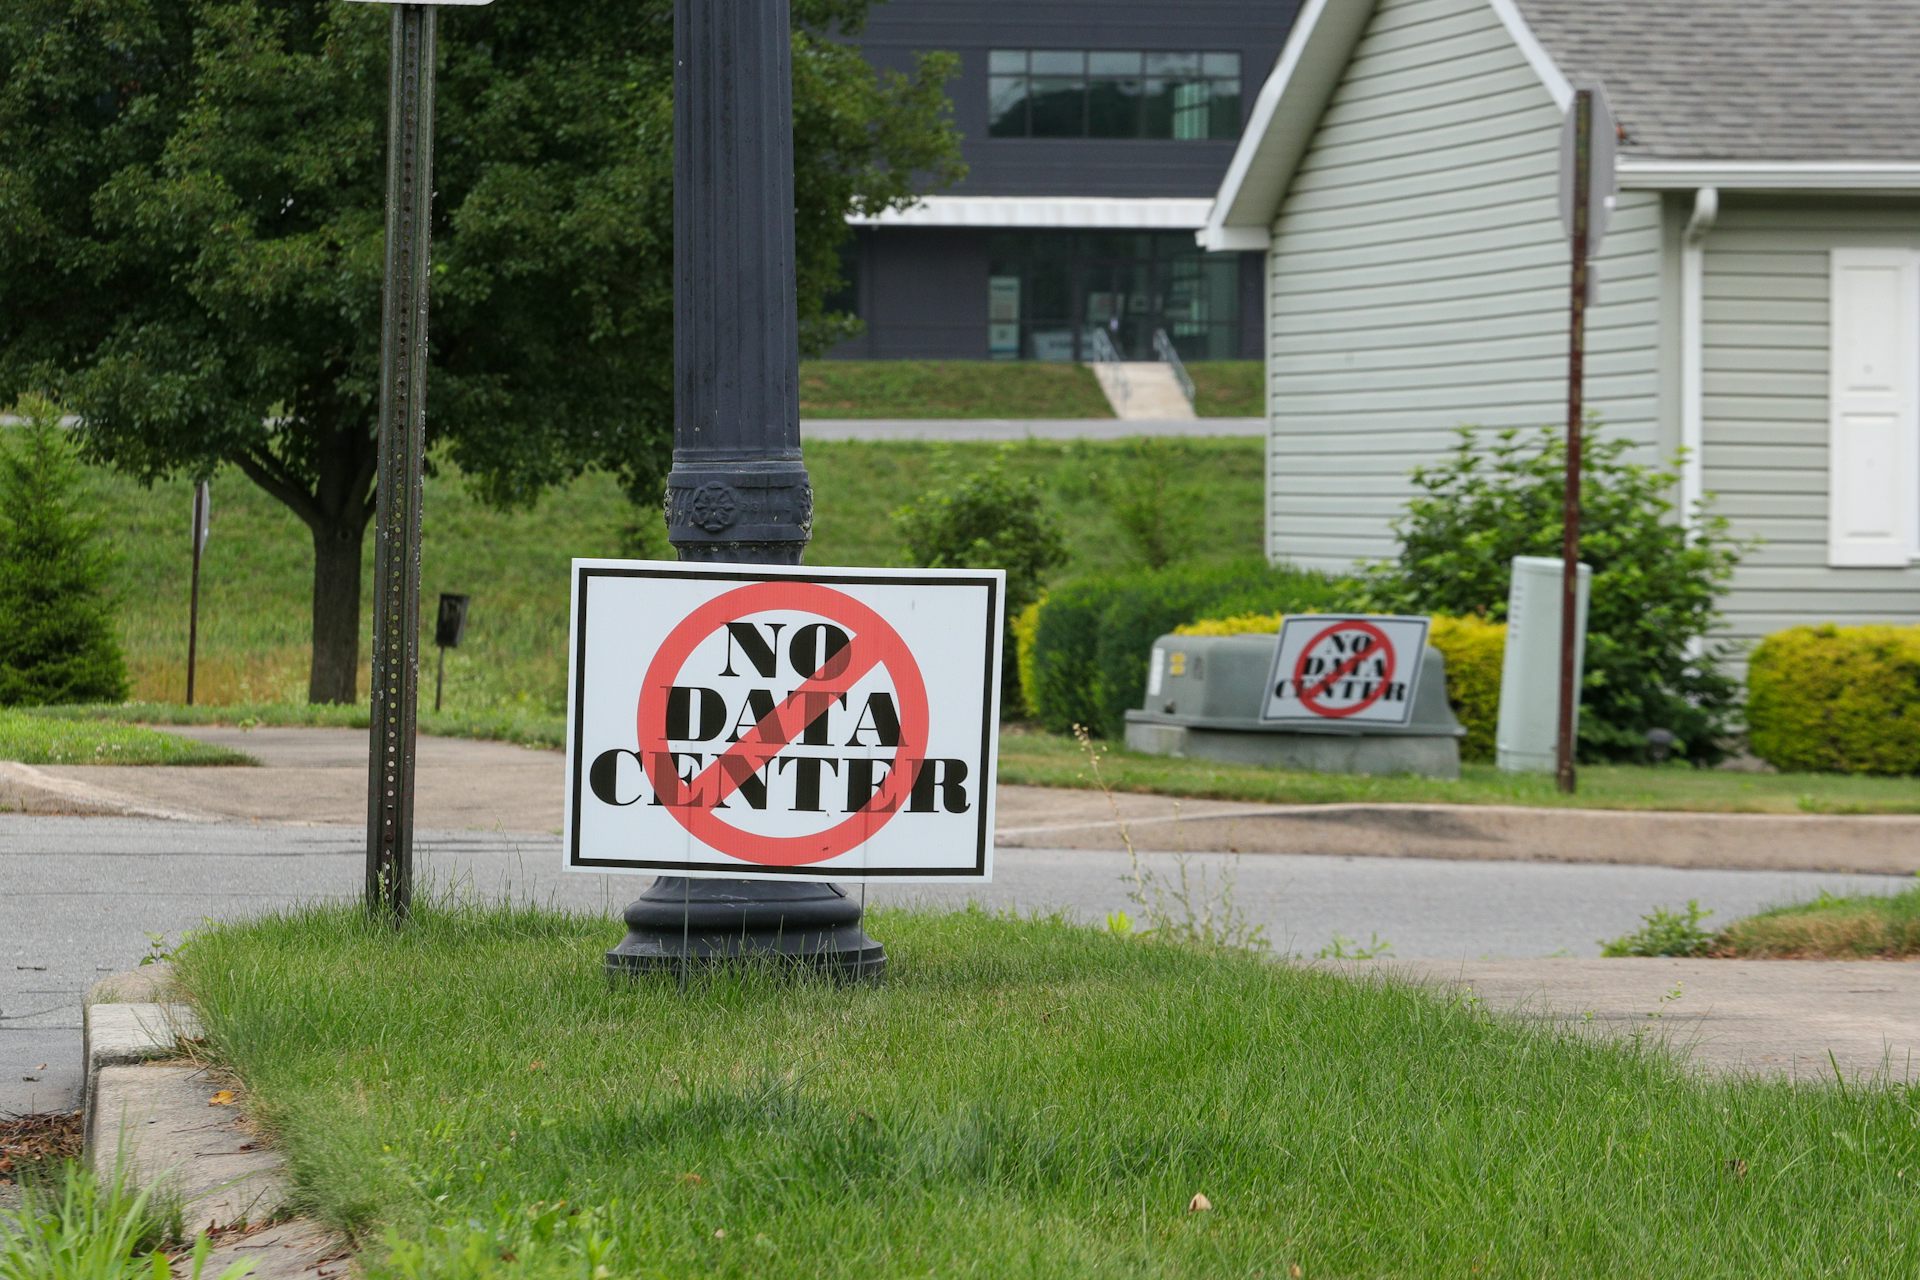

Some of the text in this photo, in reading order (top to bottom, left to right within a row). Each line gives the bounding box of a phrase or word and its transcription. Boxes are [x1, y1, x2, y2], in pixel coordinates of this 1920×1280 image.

[718, 622, 851, 681] NO
[1302, 657, 1386, 677] DATA
[1326, 634, 1373, 655] NO
[658, 686, 908, 747] DATA
[589, 748, 971, 814] CENTER
